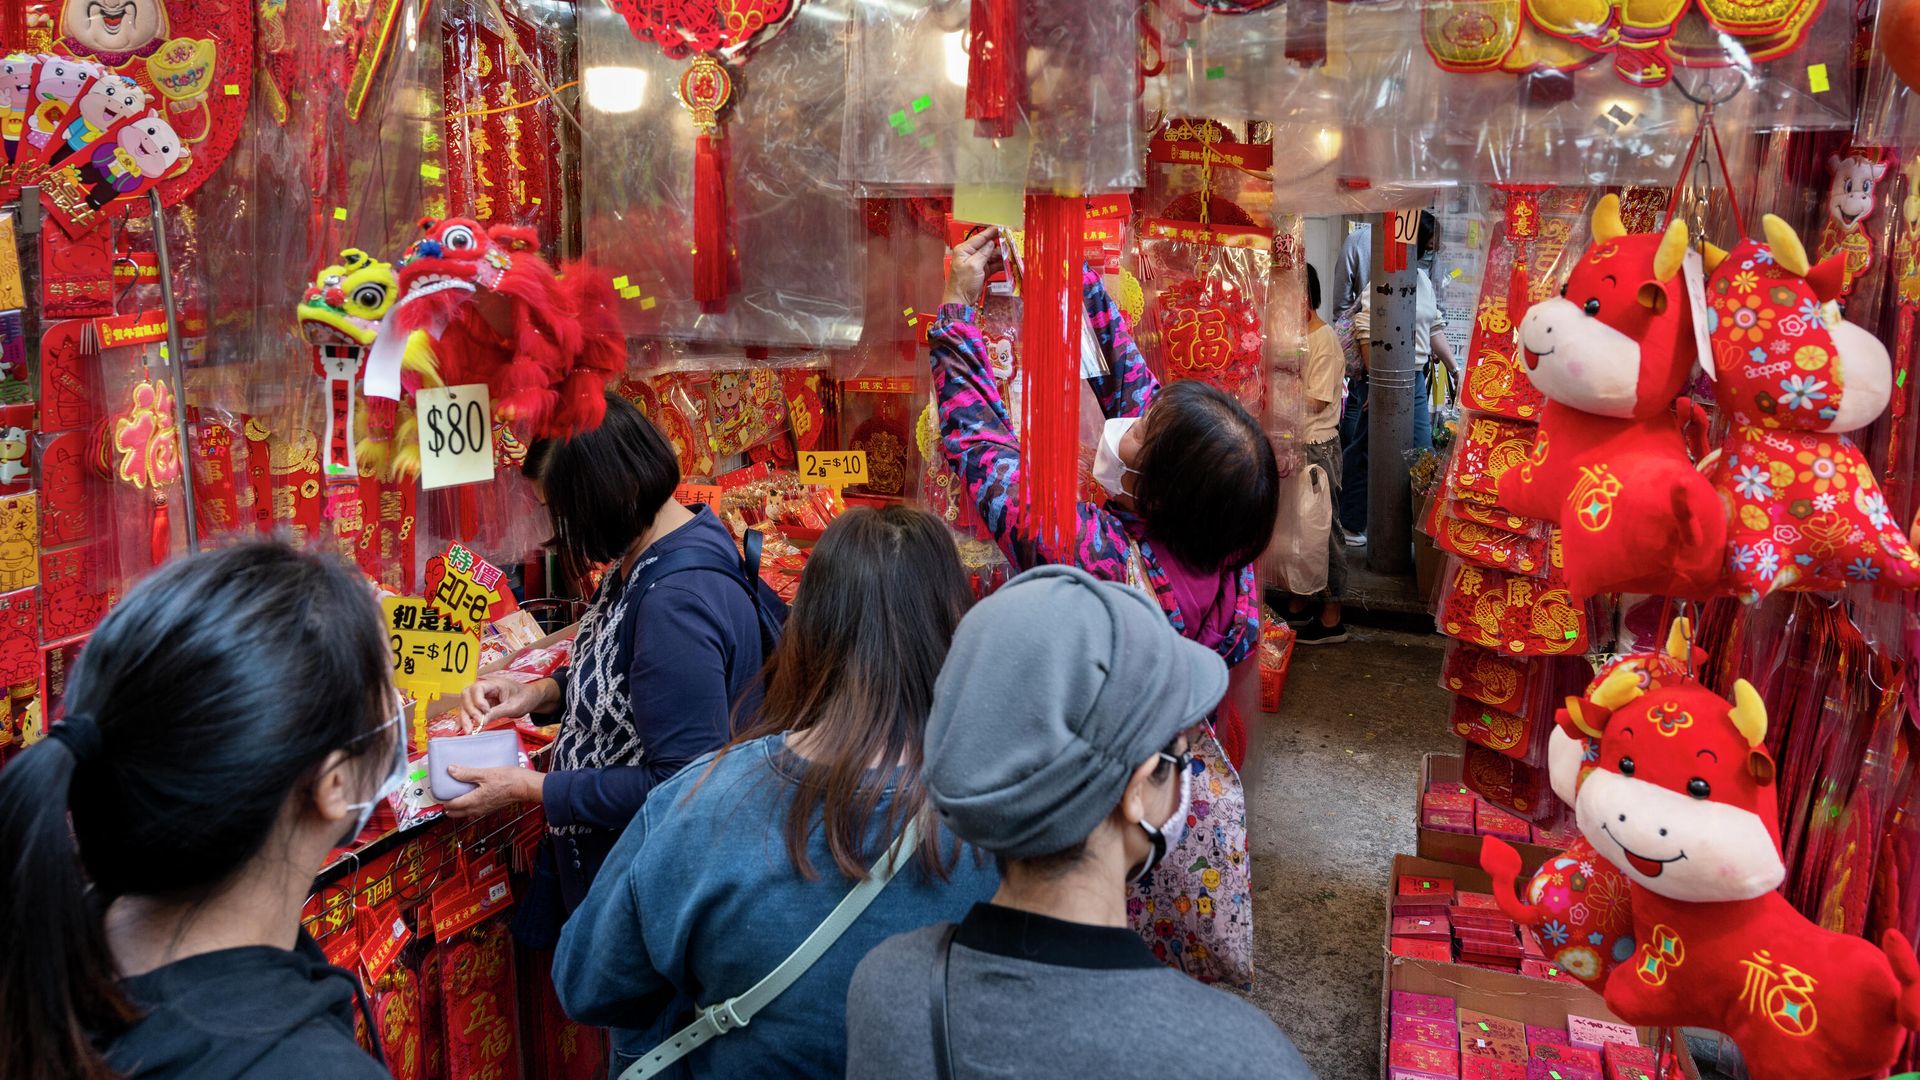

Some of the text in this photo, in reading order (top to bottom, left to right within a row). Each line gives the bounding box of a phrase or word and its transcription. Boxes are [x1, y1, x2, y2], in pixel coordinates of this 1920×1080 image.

[1168, 308, 1232, 370] 福
[427, 400, 485, 458] $80
[449, 545, 503, 593] 特價
[1506, 576, 1534, 608] 康
